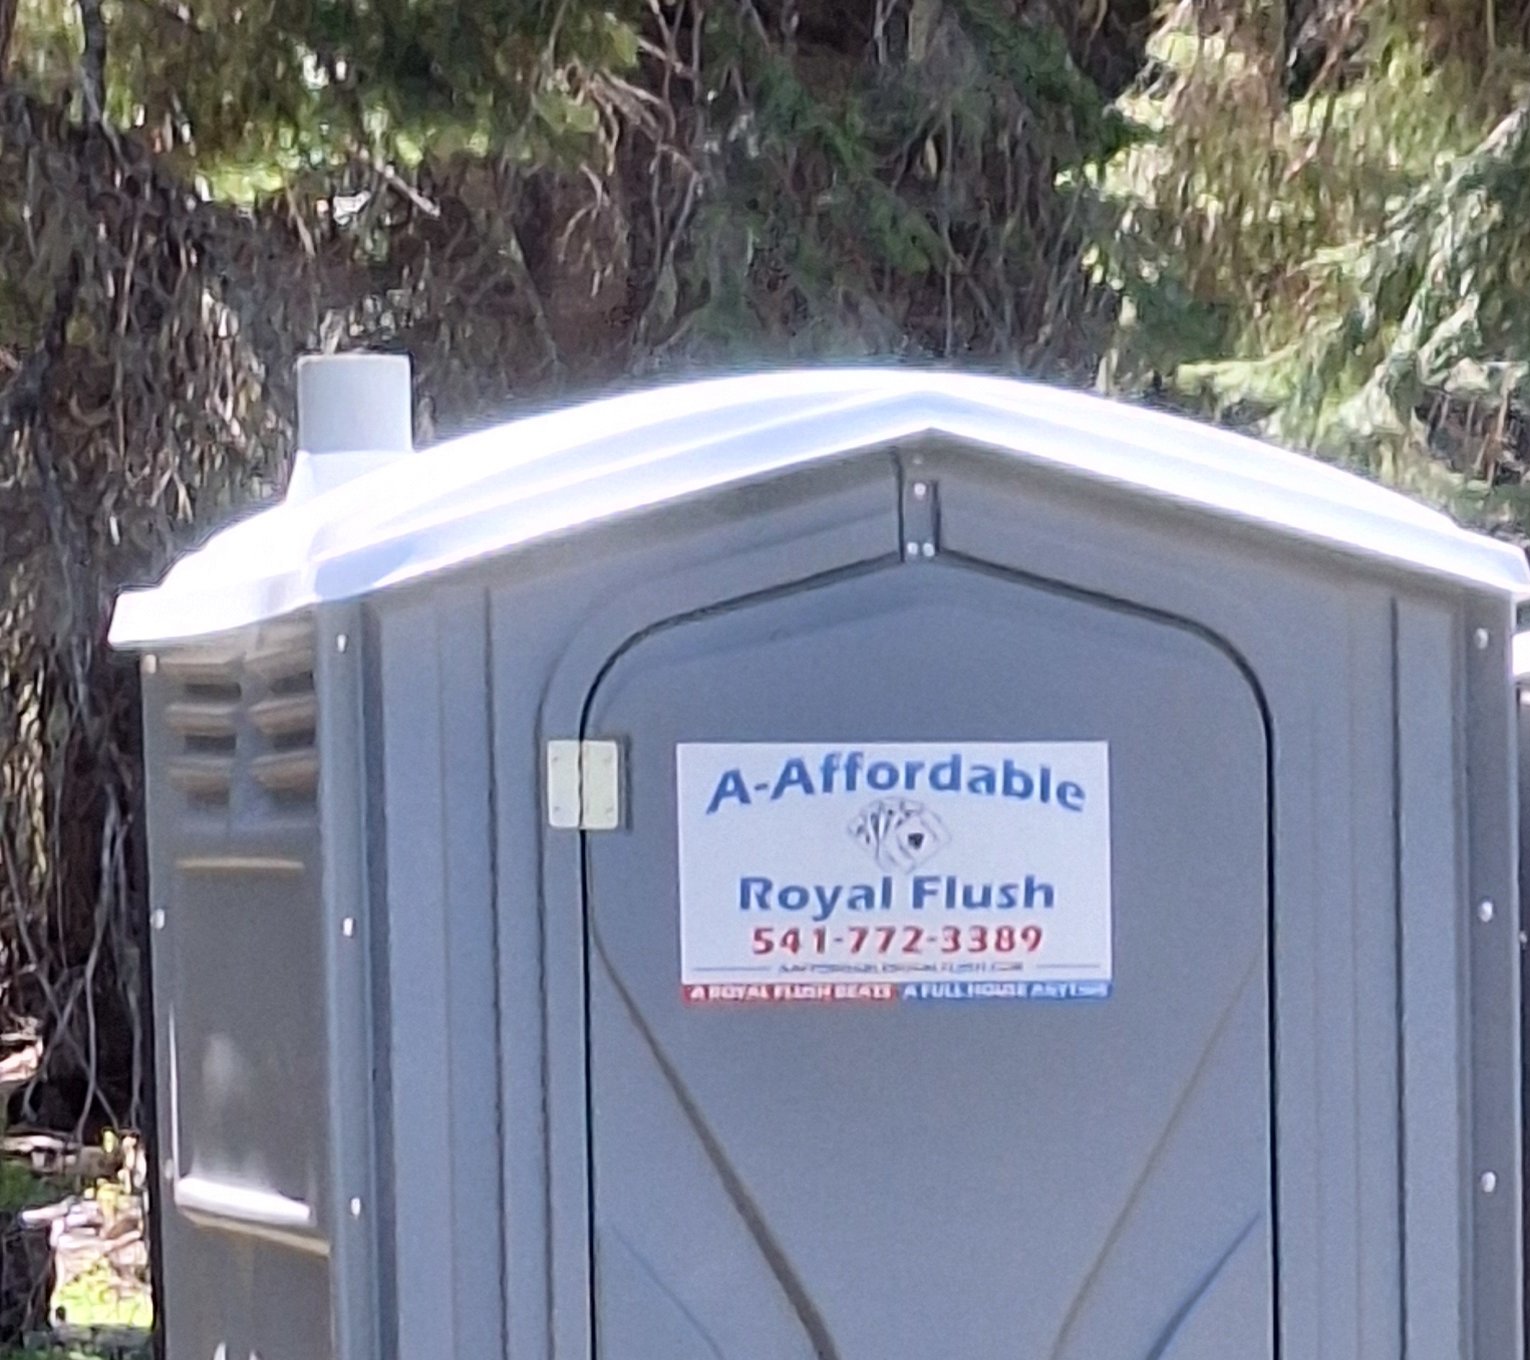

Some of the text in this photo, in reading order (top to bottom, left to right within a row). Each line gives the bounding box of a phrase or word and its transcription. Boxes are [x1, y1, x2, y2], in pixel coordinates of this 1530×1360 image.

[705, 751, 1087, 815] A-Affordable
[738, 874, 1056, 922] Royal Flush
[751, 925, 1044, 955] 541-772-3389
[921, 983, 965, 999] FULL
